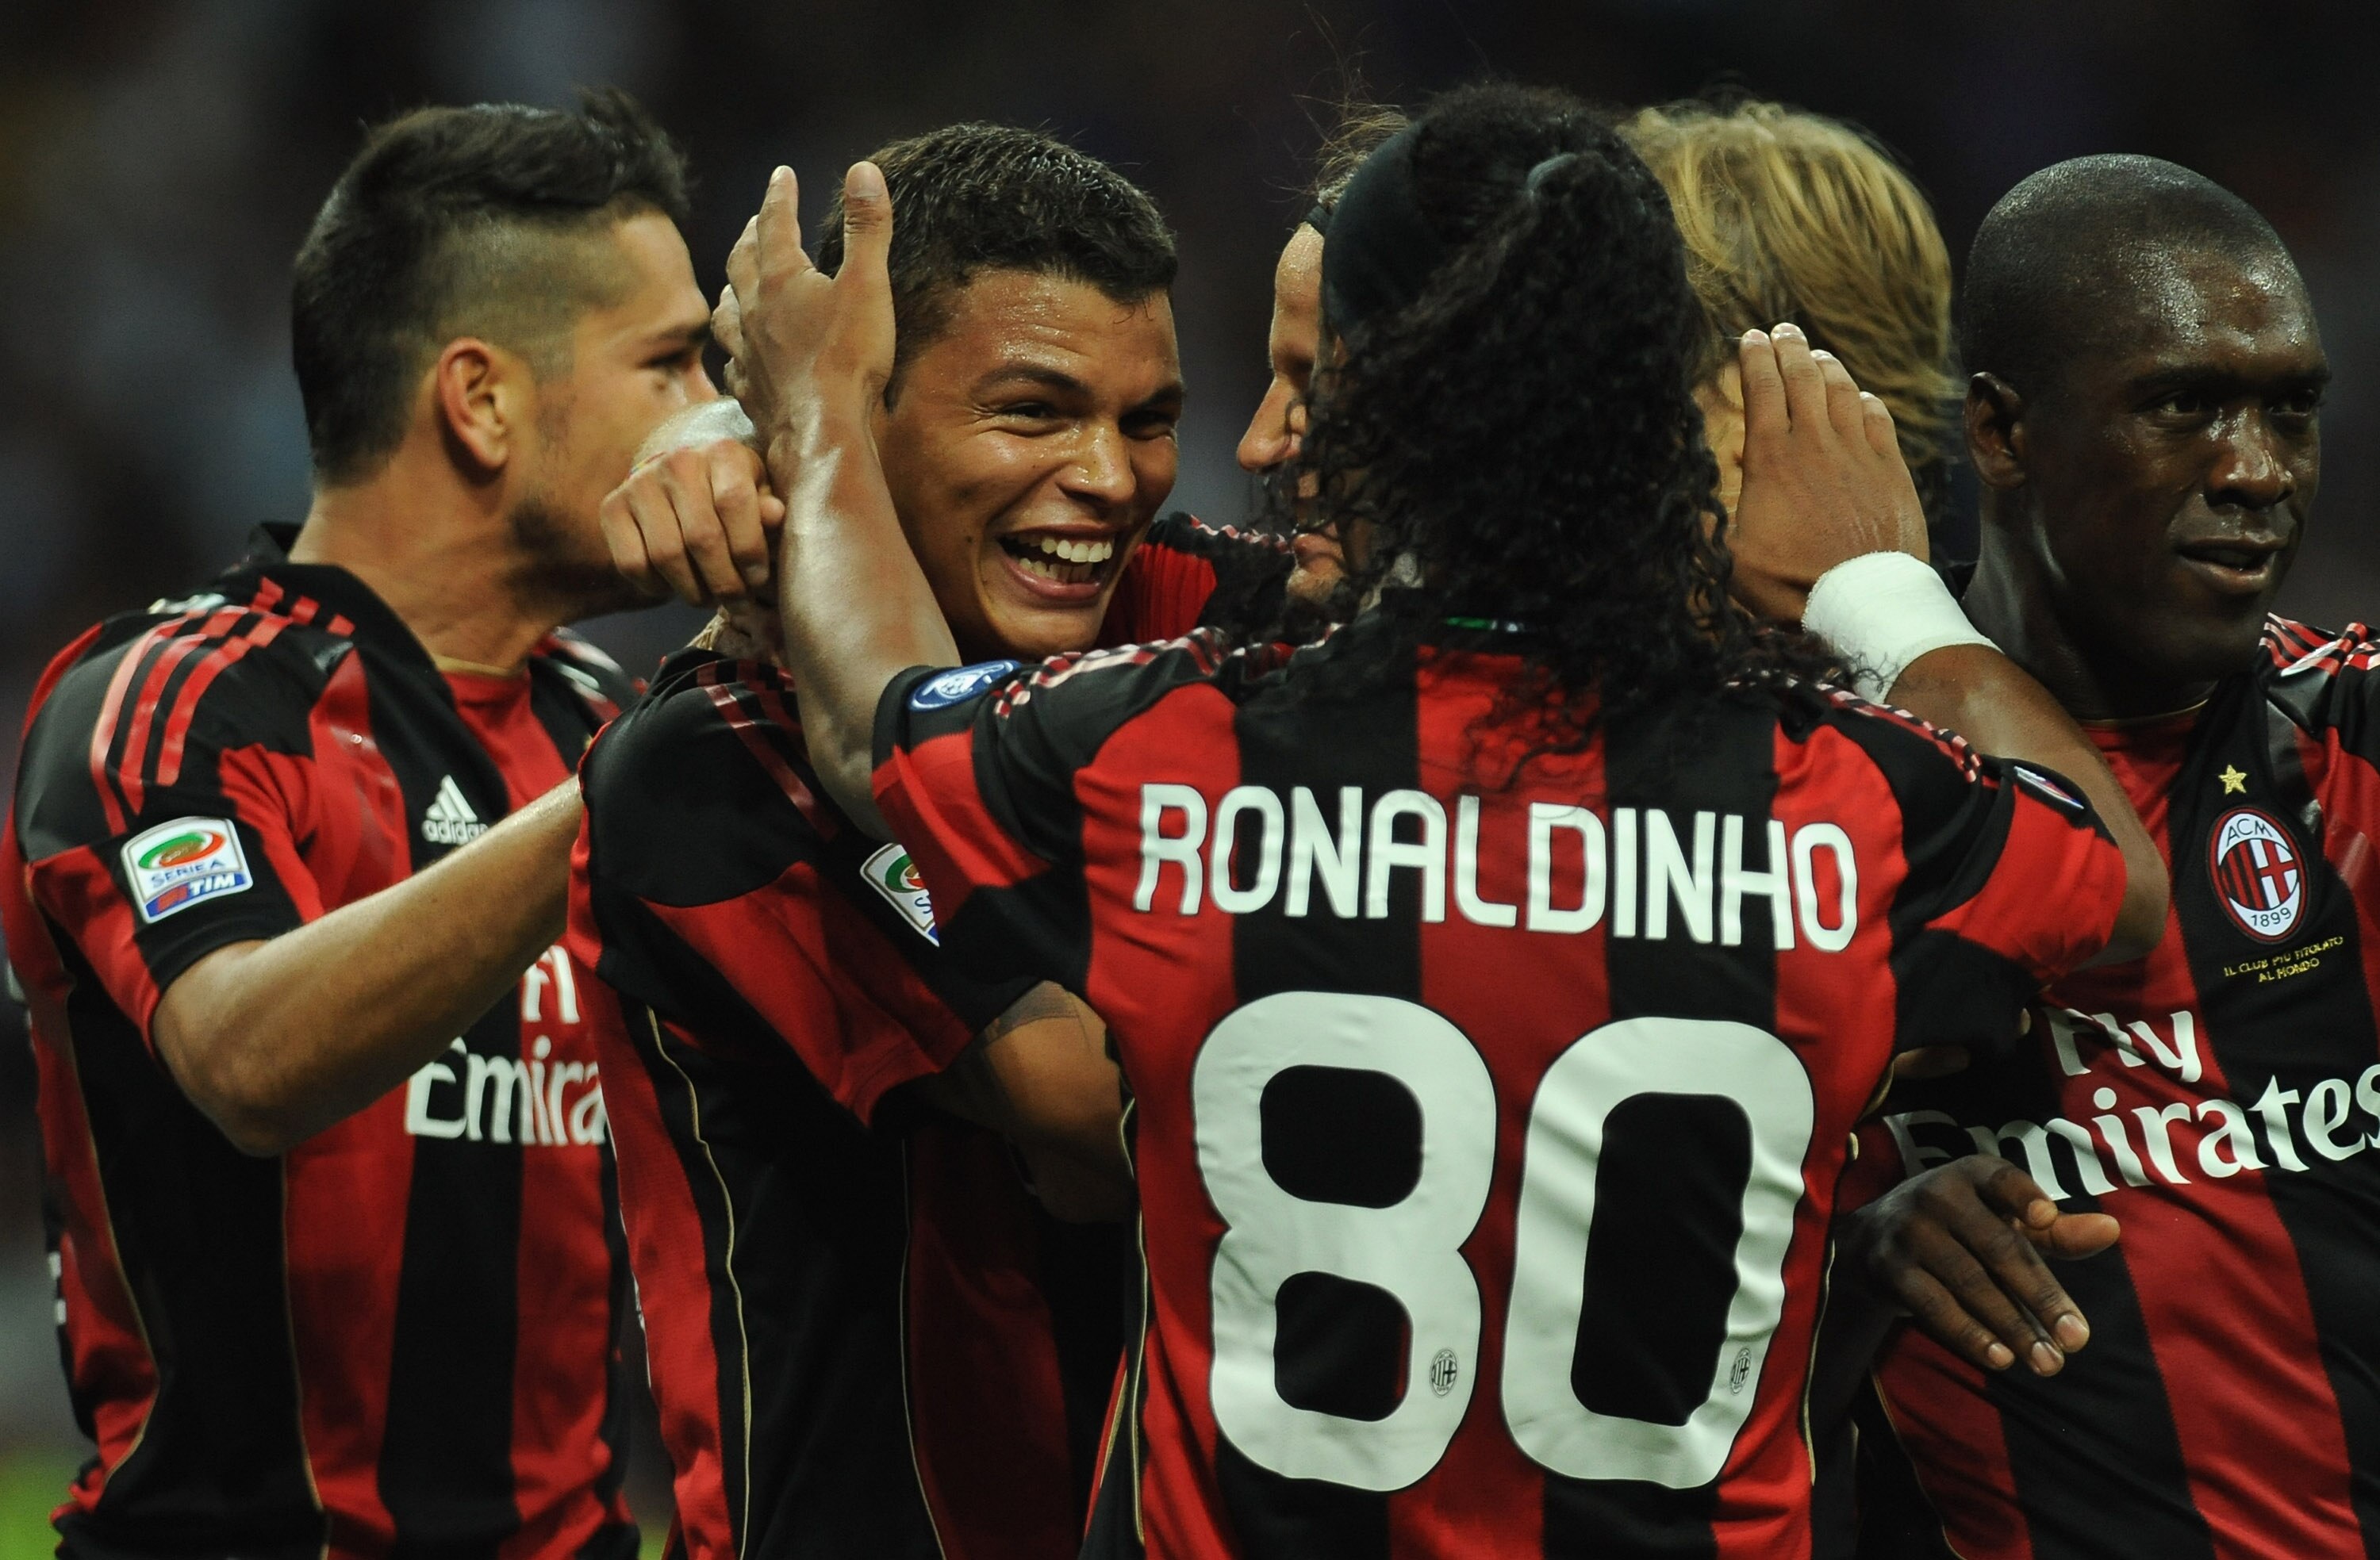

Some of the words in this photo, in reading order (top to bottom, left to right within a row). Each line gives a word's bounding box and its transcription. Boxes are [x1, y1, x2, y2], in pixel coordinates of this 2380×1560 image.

[2226, 818, 2273, 846] ACM
[151, 864, 205, 887] SERIE
[190, 872, 236, 896] TIM
[1134, 783, 1859, 952] RONALDINHO
[2251, 907, 2292, 927] 1899
[2224, 967, 2236, 977] IL
[2239, 959, 2269, 972] CLUB
[2294, 937, 2344, 960] TITOLATO
[2259, 972, 2275, 983] AL
[2276, 958, 2320, 979] MONDO
[522, 945, 580, 1024] Fl
[2043, 1007, 2202, 1083] Fly
[405, 1036, 606, 1146] Emira
[1192, 991, 1815, 1493] 80
